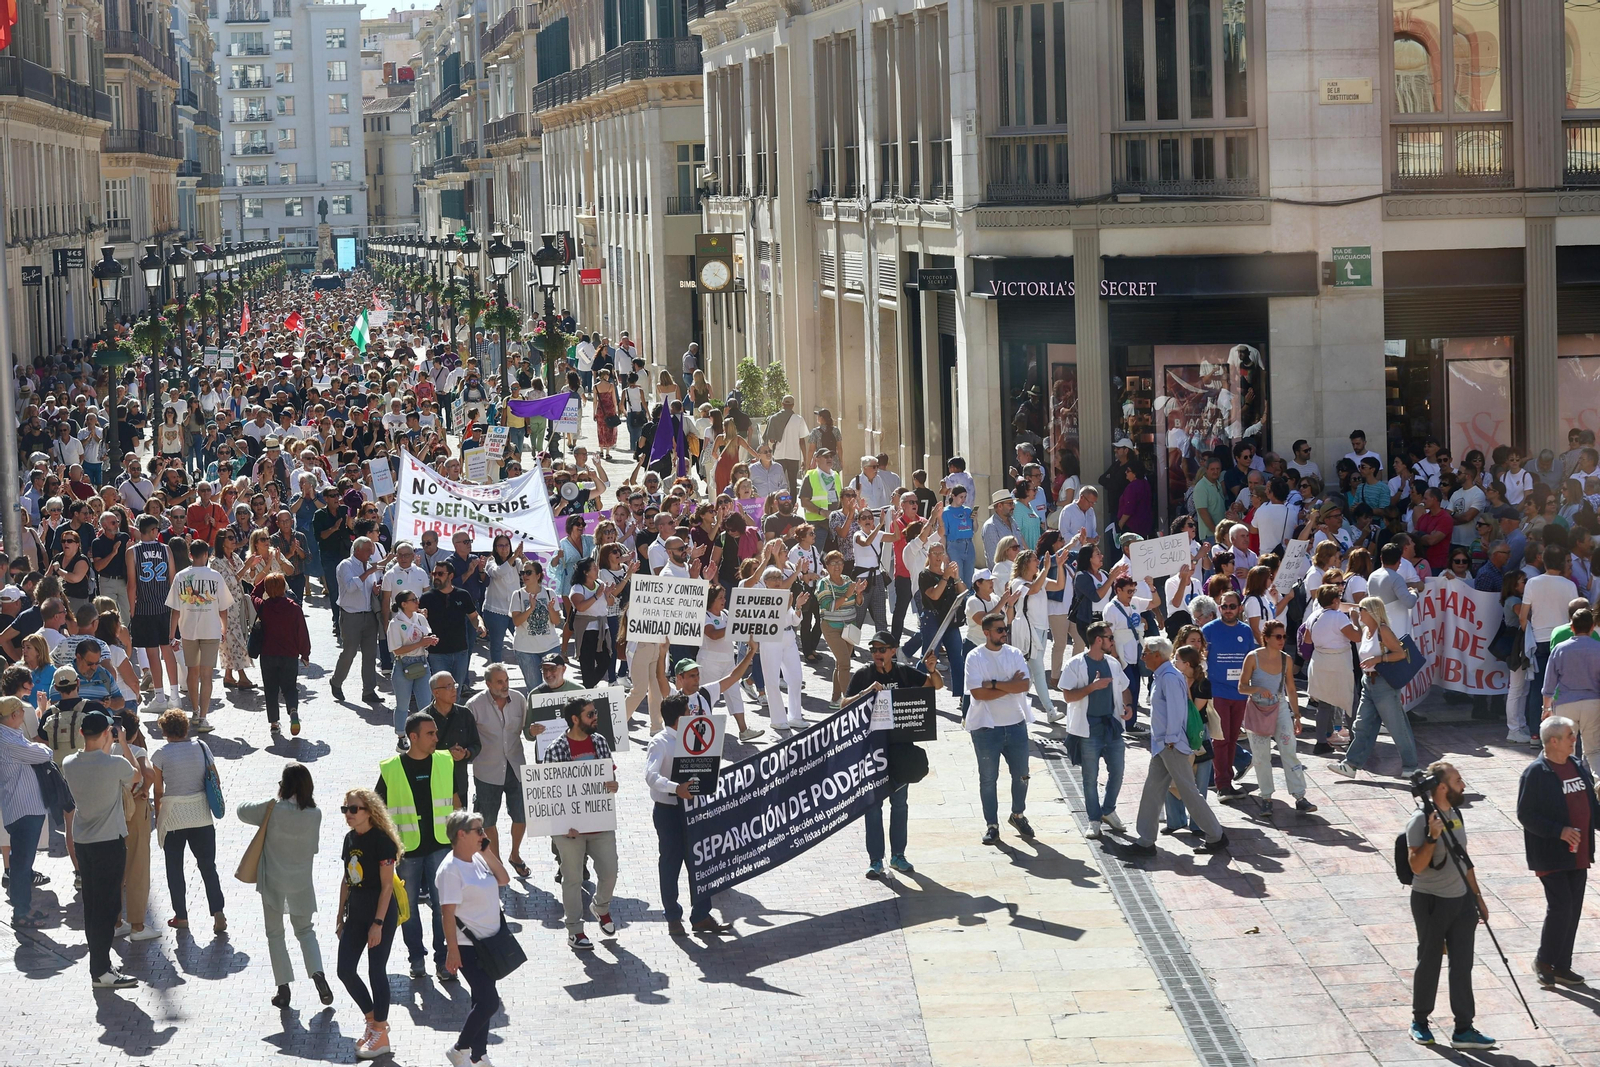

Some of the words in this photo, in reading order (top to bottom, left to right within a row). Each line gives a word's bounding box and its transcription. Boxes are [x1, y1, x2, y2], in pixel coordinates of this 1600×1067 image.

[990, 280, 1075, 296] VICTORIA'S
[1100, 280, 1157, 296] SECRET
[412, 477, 438, 495] NO
[472, 495, 530, 514] VENDE
[412, 500, 430, 516] SE
[1138, 544, 1154, 556] SE
[1159, 538, 1183, 551] VENDE
[1144, 558, 1156, 571] TU
[1160, 550, 1187, 565] SALUD
[140, 561, 168, 582] 32
[667, 582, 673, 594] Y
[674, 584, 704, 596] CONTROL
[654, 597, 675, 606] CLASE
[736, 596, 746, 604] EL
[748, 596, 784, 606] PUEBLO
[642, 608, 660, 617] PARA
[662, 609, 682, 618] TENER
[685, 611, 698, 620] UNA
[735, 608, 766, 618] SALVA
[768, 610, 780, 619] AL
[732, 623, 779, 636] PUEBLO
[1452, 626, 1487, 661] DE
[893, 699, 926, 707] democracia
[544, 763, 592, 780] SEPARACIÓN
[594, 764, 604, 776] DE
[739, 792, 752, 804] debe
[790, 768, 798, 778] de
[798, 755, 824, 776] gobierno
[826, 748, 835, 758] su
[835, 738, 852, 754] forma
[852, 733, 863, 744] de
[526, 787, 562, 800] PODERES
[567, 784, 578, 797] LA
[1562, 777, 1586, 794] VANS
[528, 802, 566, 818] PÚBLICA
[572, 801, 581, 814] SE
[585, 798, 613, 813] MUERE
[693, 802, 787, 866] SEPARACIÓN
[789, 790, 811, 820] DE
[810, 748, 888, 808] PODERES
[695, 864, 719, 881] Elección
[718, 860, 726, 870] de
[728, 858, 731, 866] 1
[768, 832, 786, 848] distrito
[790, 818, 814, 836] Elección
[814, 810, 826, 824] del
[826, 796, 855, 818] presidente
[860, 774, 890, 796] gobierno
[696, 884, 707, 894] Por
[708, 873, 730, 890] mayoría
[736, 862, 753, 876] doble
[794, 836, 805, 848] Sin
[804, 828, 820, 842] listas
[822, 824, 828, 834] de
[827, 812, 849, 831] partido
